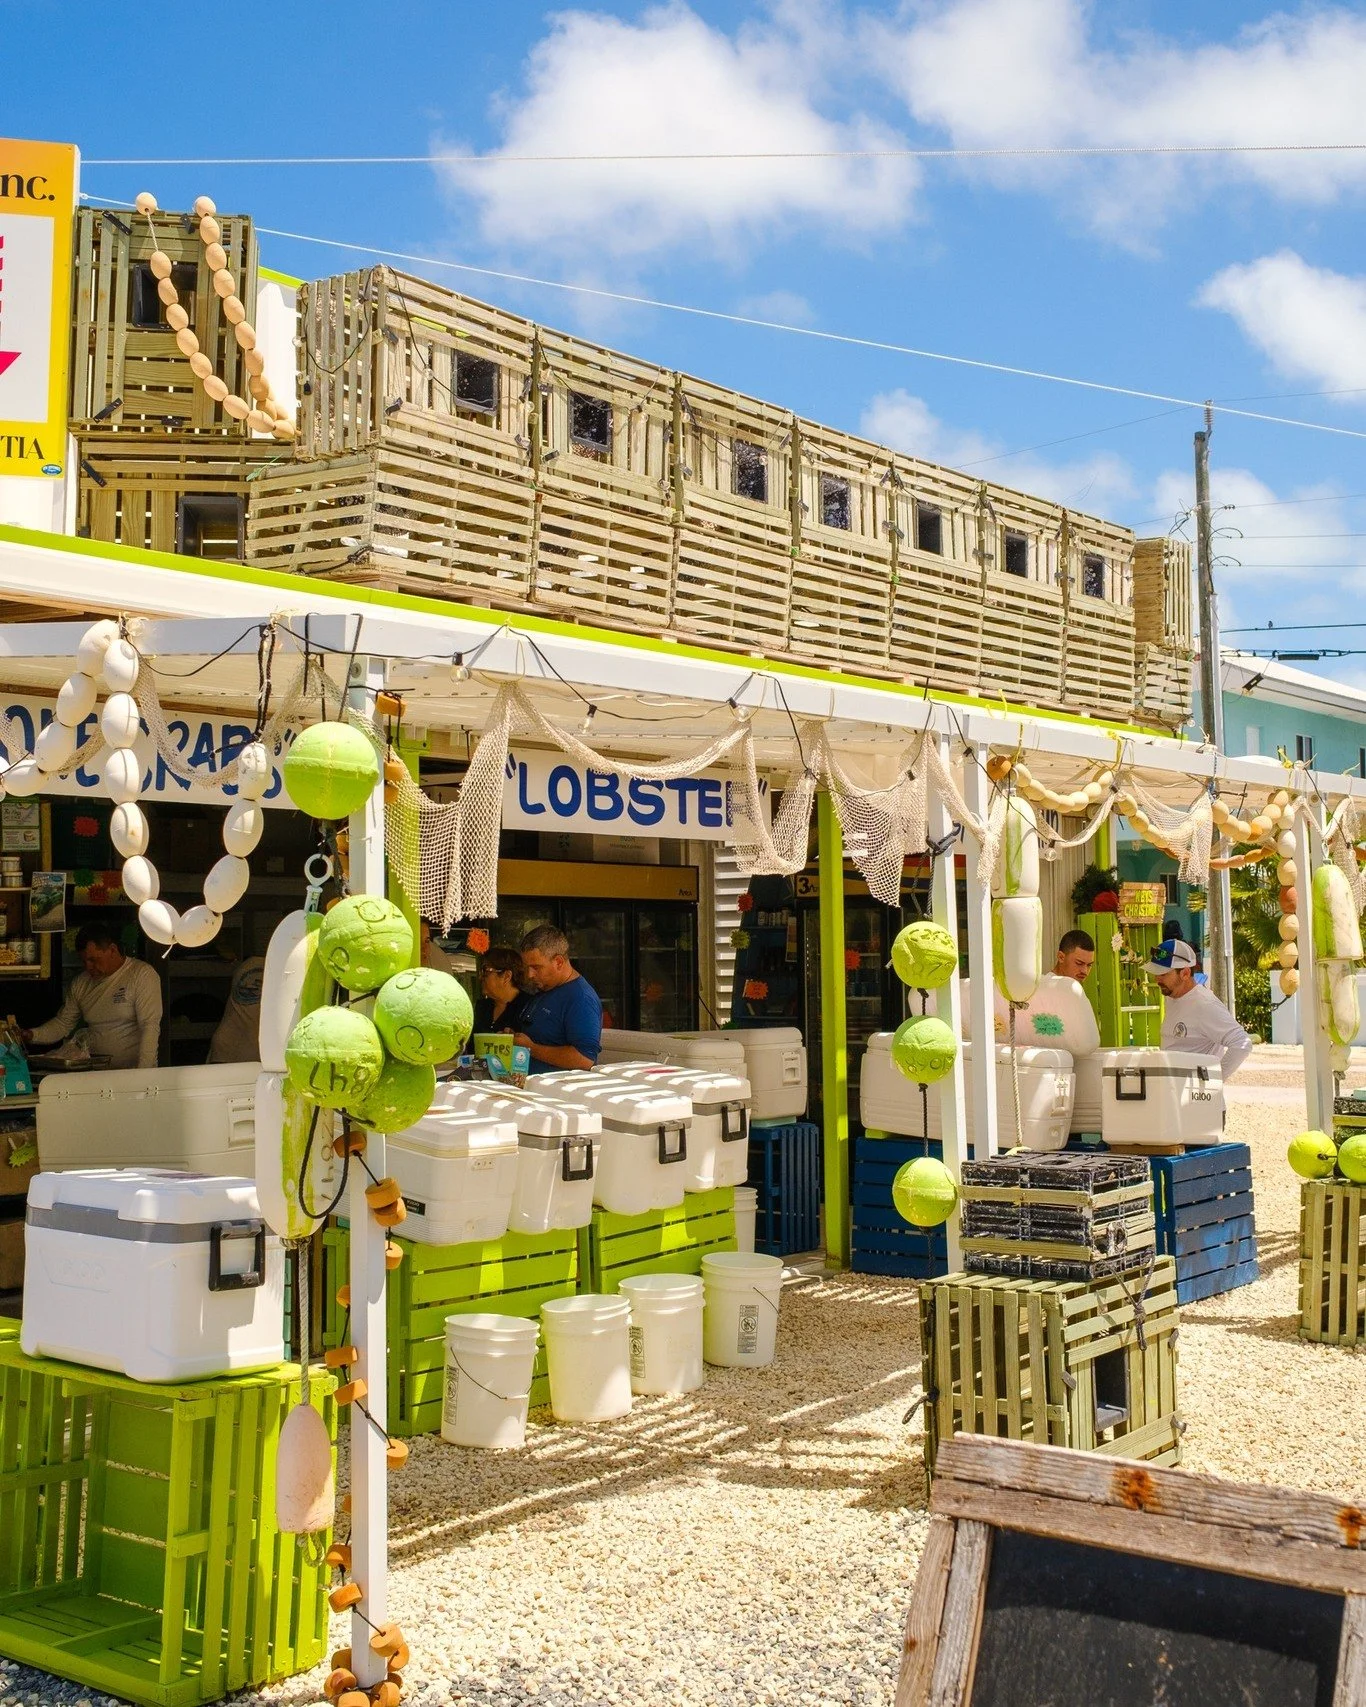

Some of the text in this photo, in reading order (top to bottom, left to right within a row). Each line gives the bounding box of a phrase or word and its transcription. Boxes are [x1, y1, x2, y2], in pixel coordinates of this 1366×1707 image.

[0, 173, 55, 201] nc.
[1, 436, 45, 460] TIA
[1191, 1091, 1211, 1102] IGLOO
